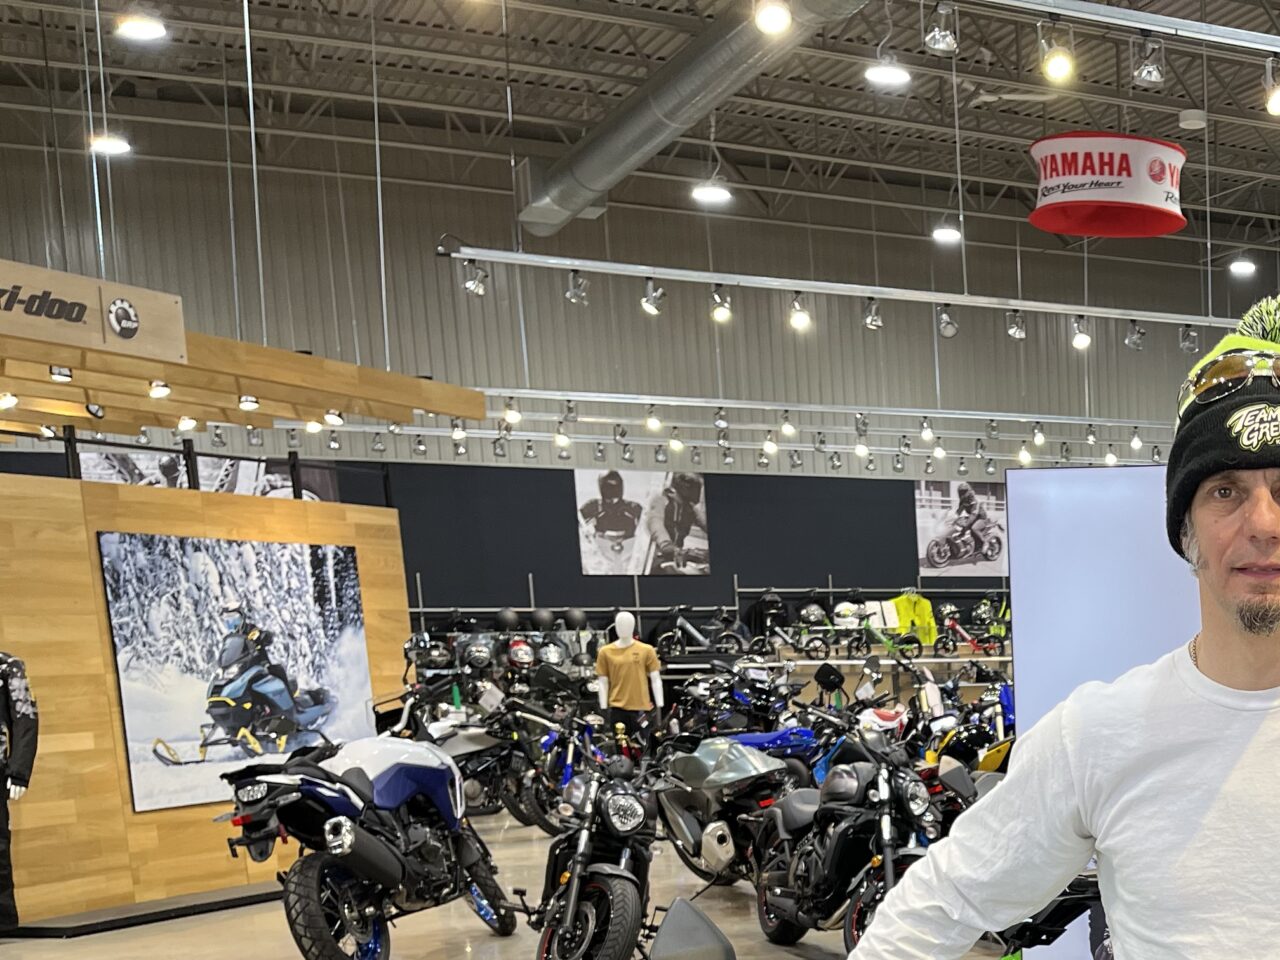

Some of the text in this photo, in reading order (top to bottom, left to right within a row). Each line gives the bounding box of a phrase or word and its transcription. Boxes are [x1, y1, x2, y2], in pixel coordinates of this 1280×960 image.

[1040, 152, 1132, 180] YAMAHA
[1061, 181, 1089, 194] Your
[1088, 179, 1123, 188] Heart
